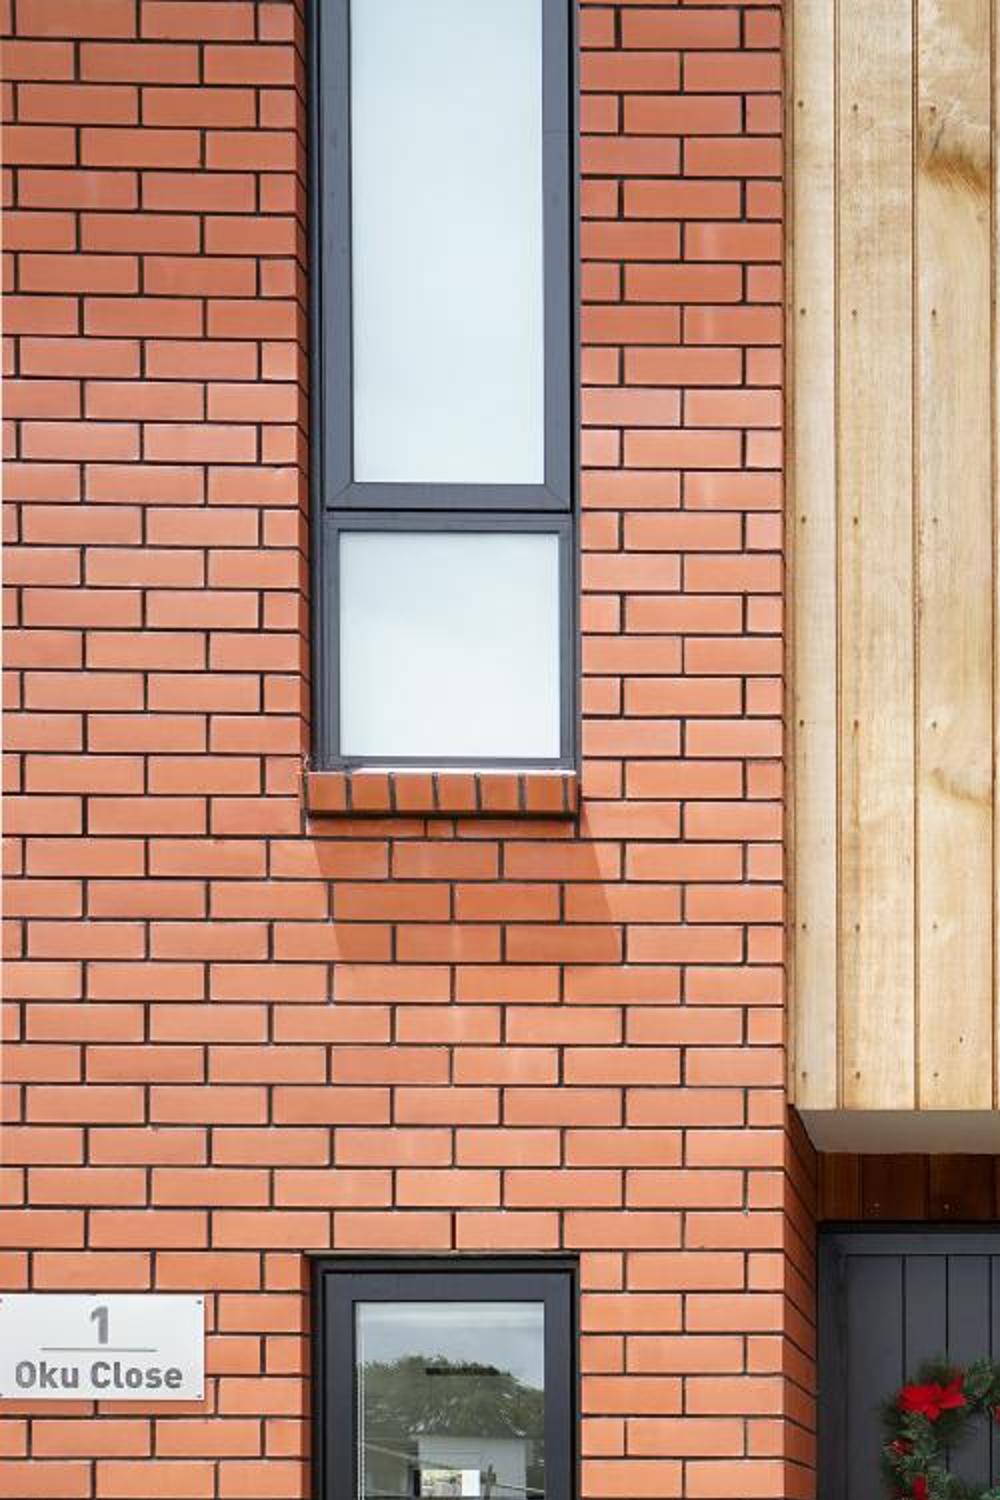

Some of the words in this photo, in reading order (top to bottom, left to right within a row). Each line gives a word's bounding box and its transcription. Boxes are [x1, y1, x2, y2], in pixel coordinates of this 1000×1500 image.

[90, 1306, 109, 1345] 1
[15, 1360, 79, 1389] Oku
[90, 1360, 183, 1389] Close
